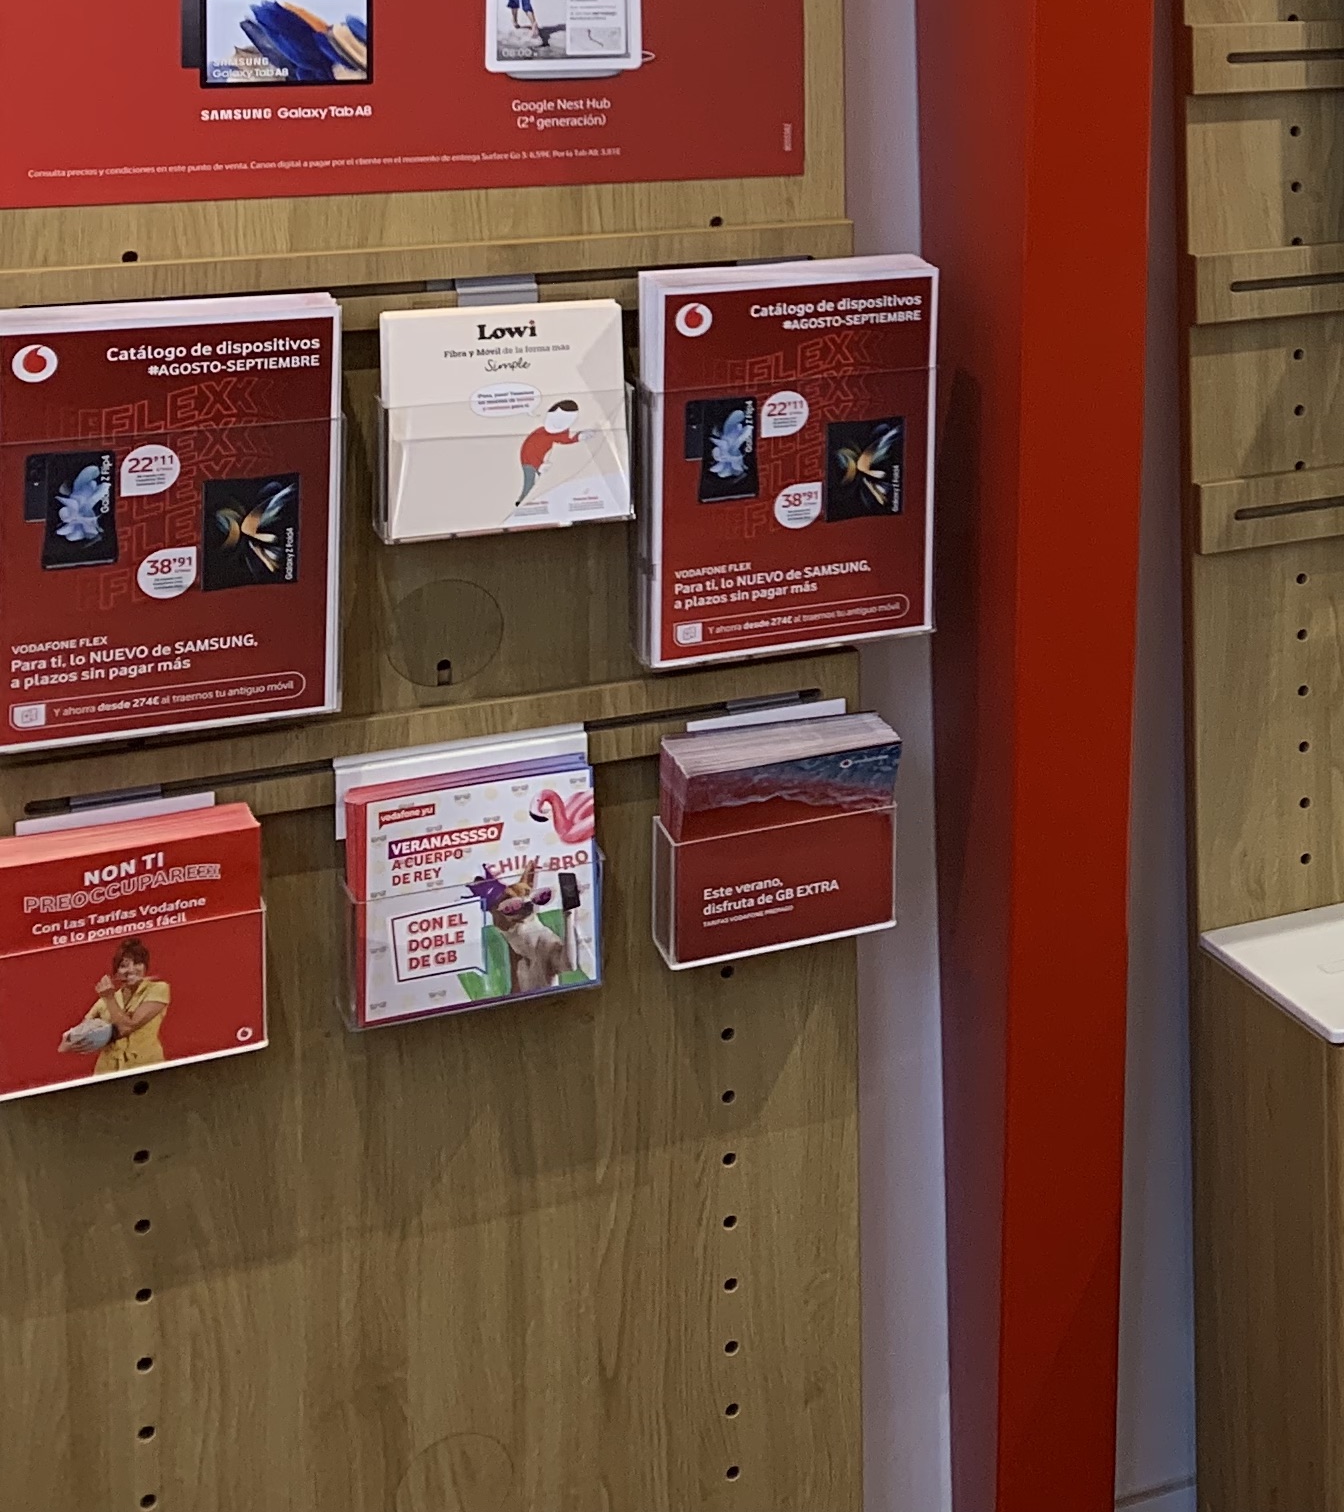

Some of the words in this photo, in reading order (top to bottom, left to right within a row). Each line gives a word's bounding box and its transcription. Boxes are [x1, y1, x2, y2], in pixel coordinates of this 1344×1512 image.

[201, 108, 272, 121] SAMSUNG
[277, 107, 328, 120] Galaxy
[329, 106, 354, 117] Tab
[355, 105, 372, 117] A8
[511, 99, 555, 114] Google
[557, 98, 584, 110] Nest
[586, 97, 611, 109] Hub
[536, 114, 607, 131] generación)
[750, 301, 814, 318] Catálogo
[817, 300, 835, 313] de
[837, 294, 922, 313] dispositivos
[477, 319, 537, 341] Lowi
[106, 345, 187, 362] Catálogo
[190, 343, 212, 357] de
[216, 337, 320, 358] dispositivos
[444, 350, 467, 358] Fibra
[476, 347, 501, 356] Móvil
[148, 354, 320, 377] #AGOSTO-SEPTIEMBRE
[485, 357, 531, 372] Simple
[11, 640, 76, 655] VODAFONE
[79, 636, 108, 646] FLEX
[10, 655, 47, 672] Para
[69, 652, 86, 666] lo
[89, 645, 148, 664] NUEVO
[151, 644, 171, 656] de
[10, 678, 20, 689] a
[24, 670, 78, 691] plazos
[81, 666, 106, 681] sin
[108, 663, 154, 681] pagar
[157, 657, 191, 673] más
[53, 707, 61, 717] Y
[62, 704, 96, 716] ahorra
[97, 699, 131, 713] desde
[132, 697, 160, 709] 274€
[161, 695, 171, 705] al
[215, 689, 226, 699] tu
[227, 684, 265, 698] antiguo
[267, 679, 295, 693] móvil
[380, 809, 421, 822] vodafone
[421, 807, 434, 817] yu
[84, 858, 136, 887] NON
[141, 852, 165, 871] TI
[391, 859, 401, 871] A
[404, 848, 463, 870] CUERPO
[549, 850, 589, 871] BRO
[392, 873, 411, 886] DE
[414, 867, 442, 883] REY
[703, 888, 733, 900] Este
[736, 878, 783, 894] verano,
[703, 897, 755, 916] disfruta
[757, 893, 773, 905] de
[775, 889, 794, 901] GB
[796, 879, 840, 898] EXTRA
[32, 922, 61, 936] Con
[63, 917, 86, 930] las
[88, 908, 137, 925] Tarifas
[139, 896, 206, 917] Vodafone
[408, 916, 443, 935] CON
[447, 913, 467, 928] EL
[52, 933, 68, 946] te
[70, 930, 85, 943] lo
[87, 919, 154, 942] ponemos
[156, 912, 187, 928] fácil
[408, 930, 465, 953] DOBLE
[408, 954, 431, 971] DE
[434, 949, 457, 966] GB
